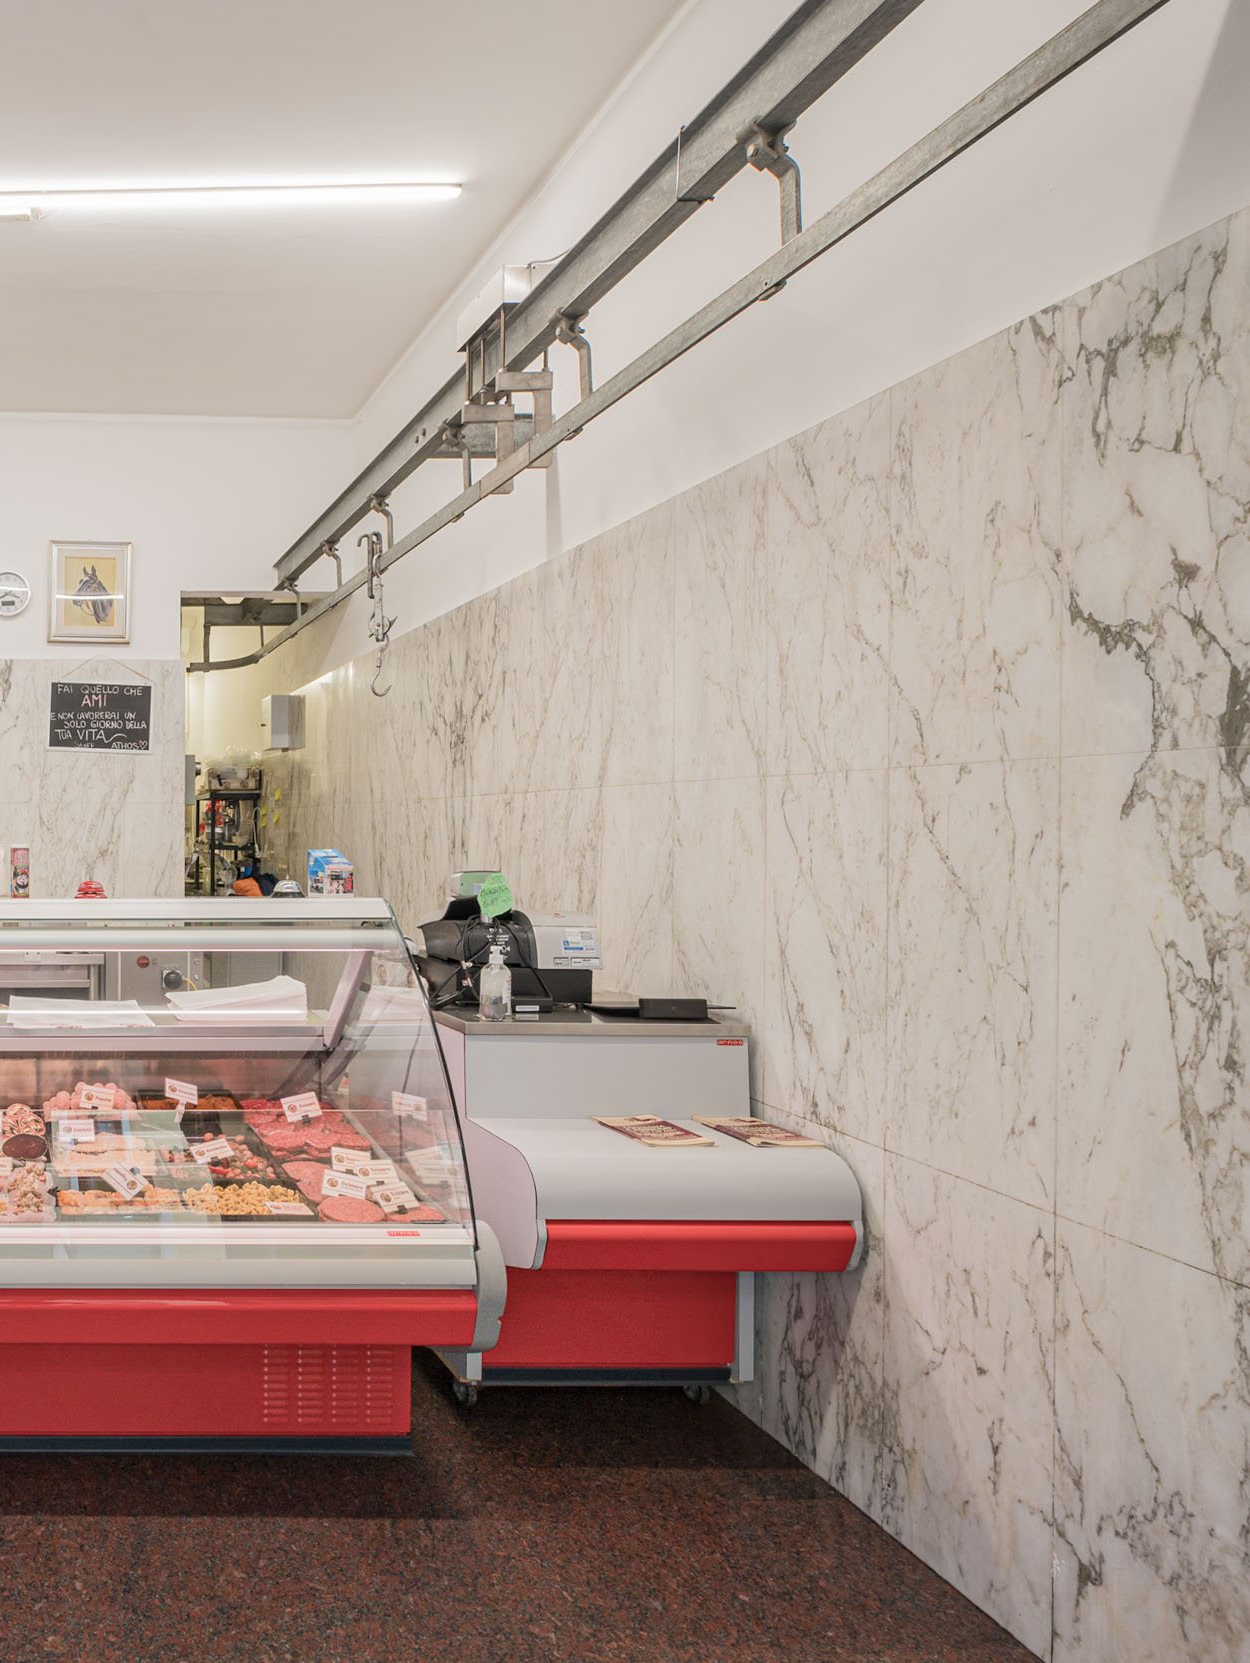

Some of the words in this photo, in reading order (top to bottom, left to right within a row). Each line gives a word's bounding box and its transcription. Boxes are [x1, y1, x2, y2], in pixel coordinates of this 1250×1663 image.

[57, 684, 73, 694] FAI
[80, 684, 119, 695] QUELLO
[123, 686, 143, 696] CHE
[81, 694, 107, 708] AMI
[50, 712, 56, 720] E
[57, 711, 74, 720] NON
[124, 711, 136, 720] UN
[63, 720, 86, 728] SOLO
[90, 720, 123, 729] GIORNO
[125, 720, 147, 729] DELLA
[54, 729, 72, 741] TUA
[76, 729, 108, 742] VITA
[111, 741, 139, 749] ATHOS
